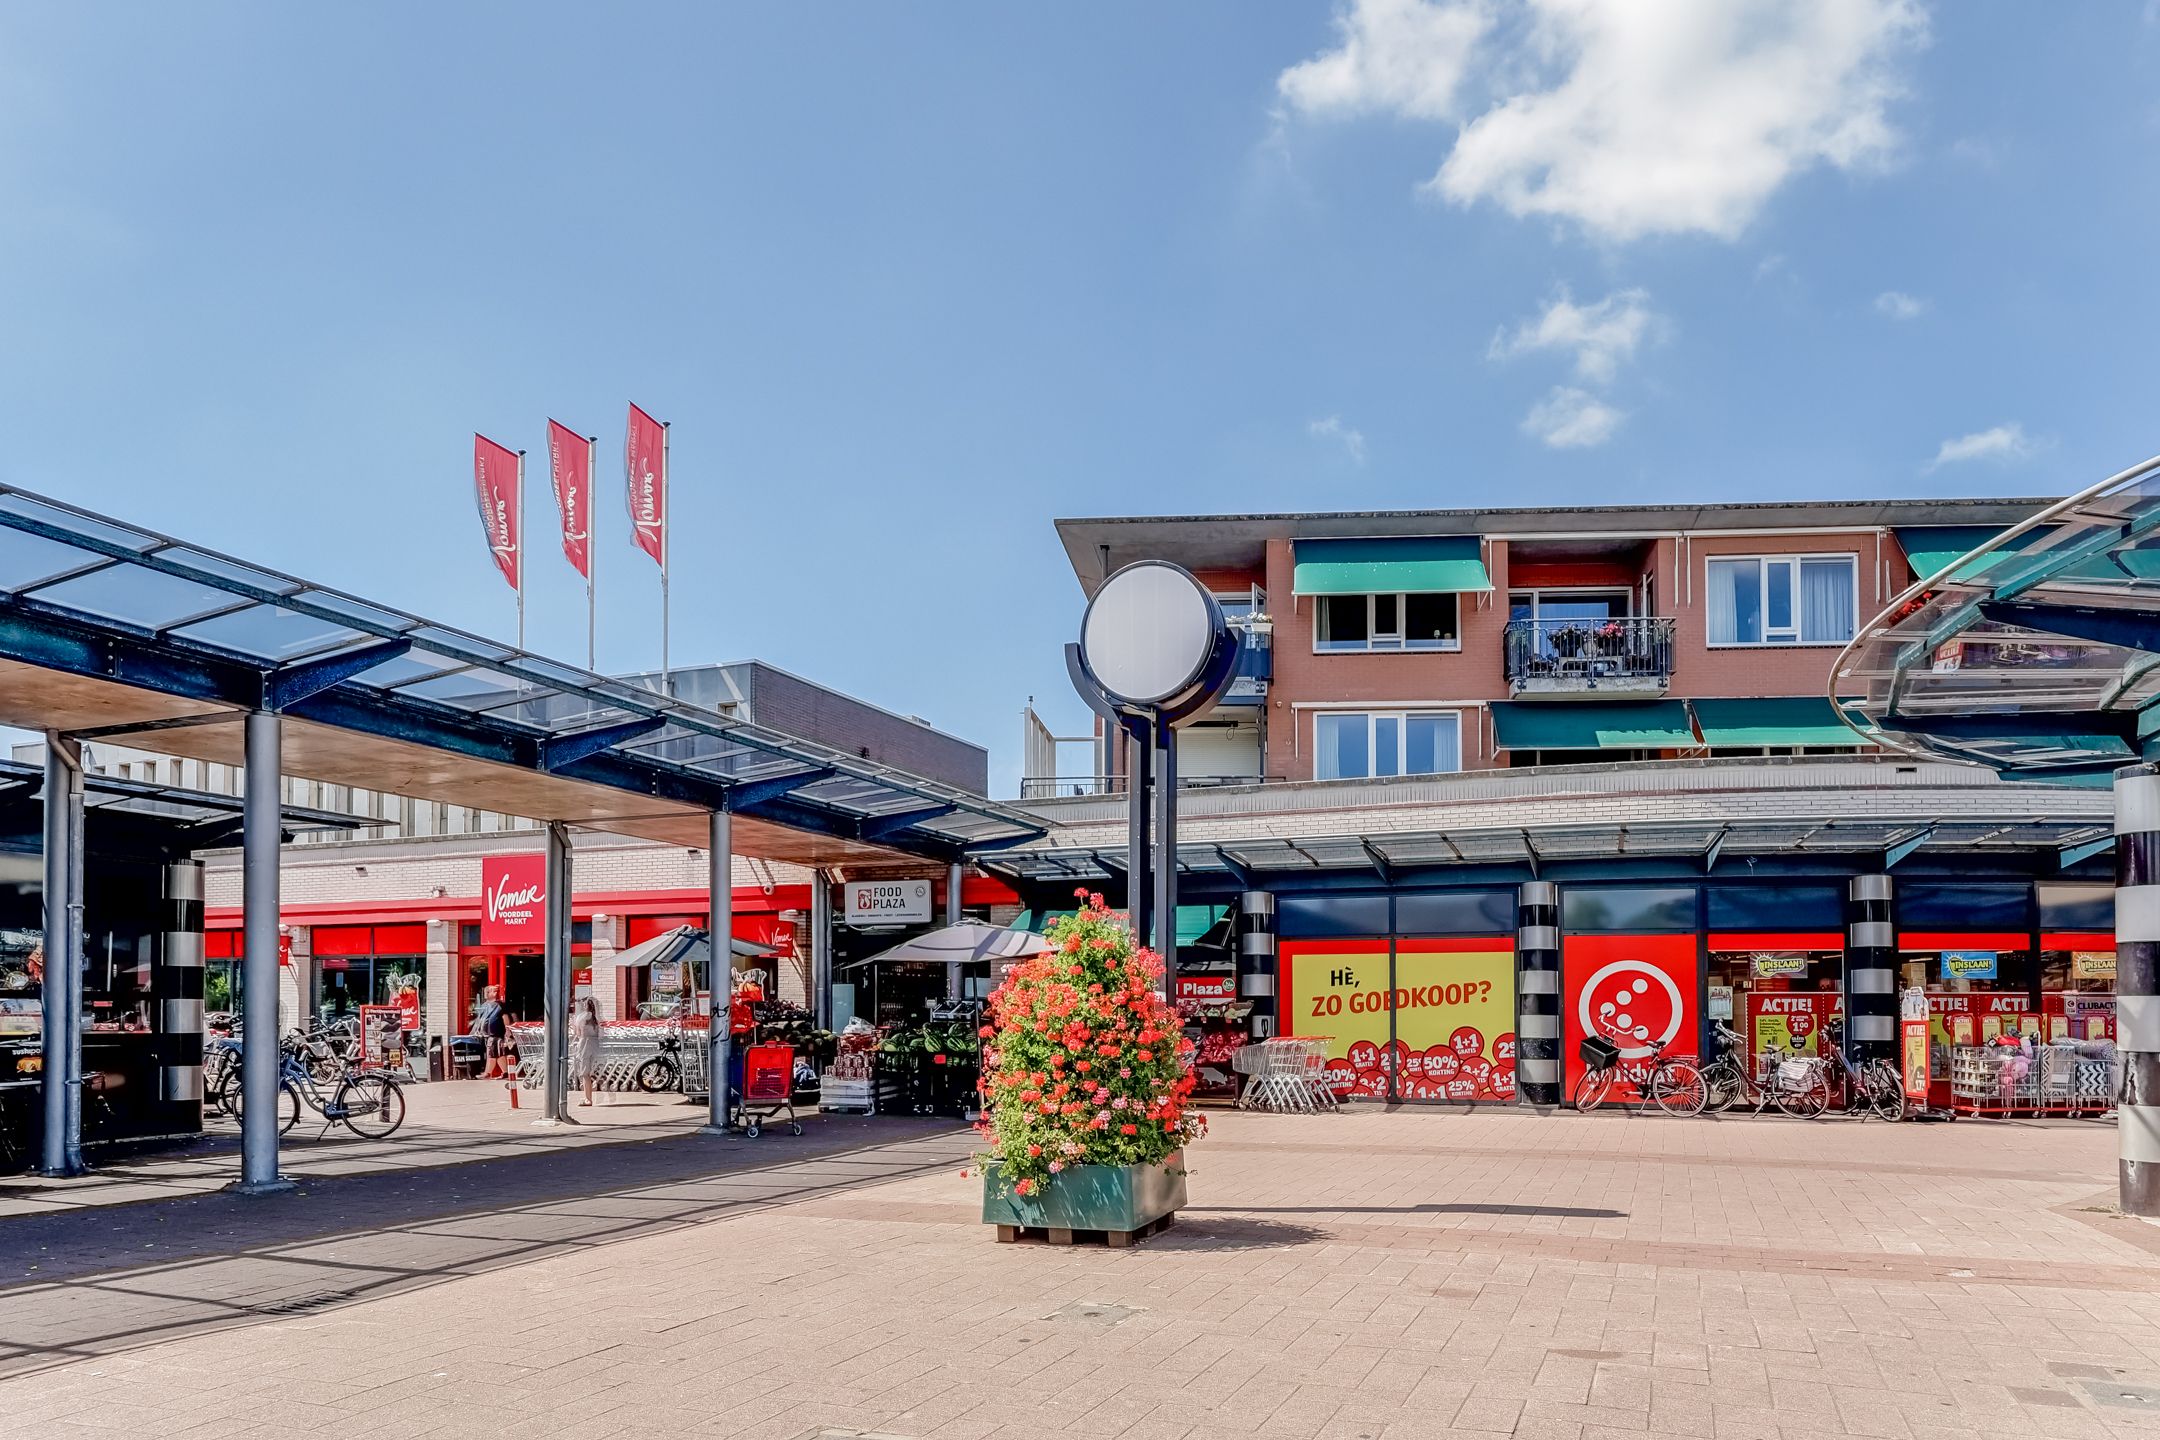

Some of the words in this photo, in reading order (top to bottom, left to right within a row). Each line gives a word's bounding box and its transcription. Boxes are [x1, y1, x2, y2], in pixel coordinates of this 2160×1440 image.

[488, 874, 545, 922] Vomar
[874, 887, 902, 897] FOOD
[873, 899, 906, 909] PLAZA
[1331, 967, 1360, 988] HÈ,
[1184, 983, 1223, 995] Plaza
[1312, 995, 1342, 1017] ZO
[1350, 981, 1492, 1014] GOEDKOOP?
[1761, 998, 1812, 1013] ACTIE!
[1929, 997, 1968, 1012] CTIE!
[1990, 997, 2029, 1011] ACTI
[1453, 1034, 1479, 1049] 1+1
[1352, 1048, 1376, 1063] 1+1
[1381, 1051, 1401, 1066] 21
[1424, 1055, 1458, 1069] 50%
[1323, 1068, 1356, 1083] 50%
[1492, 1071, 1515, 1086] 1+1
[1418, 1085, 1448, 1099] 1+1
[1448, 1081, 1475, 1091] 25%
